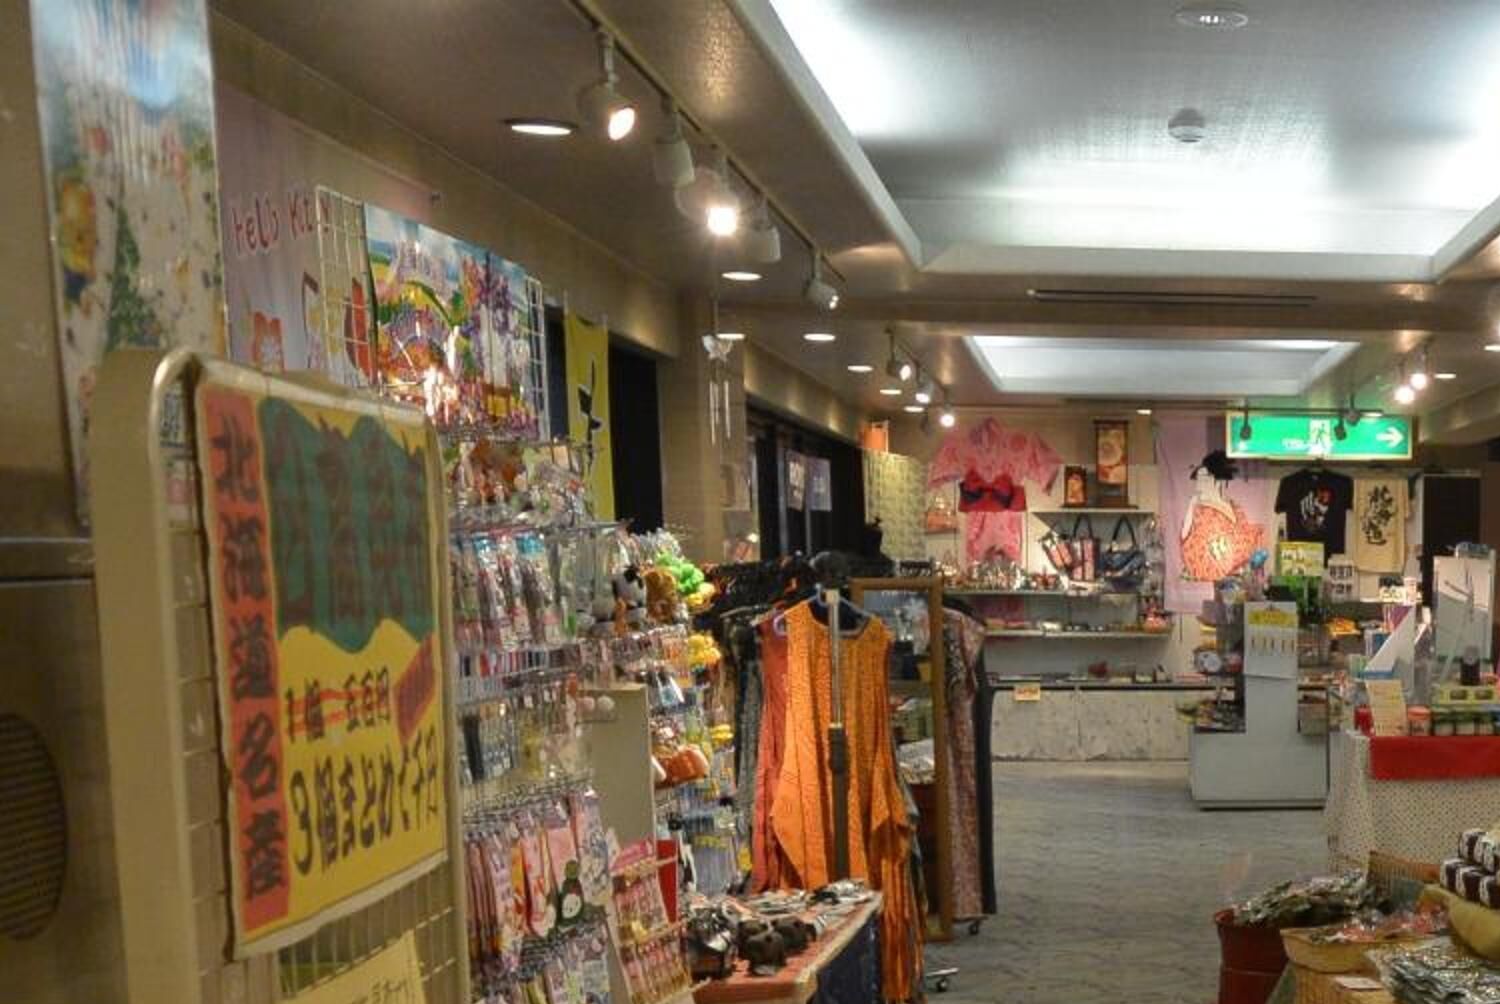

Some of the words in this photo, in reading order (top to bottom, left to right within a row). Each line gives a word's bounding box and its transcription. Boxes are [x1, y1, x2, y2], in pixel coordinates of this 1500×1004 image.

[212, 412, 285, 900] 北海道名産
